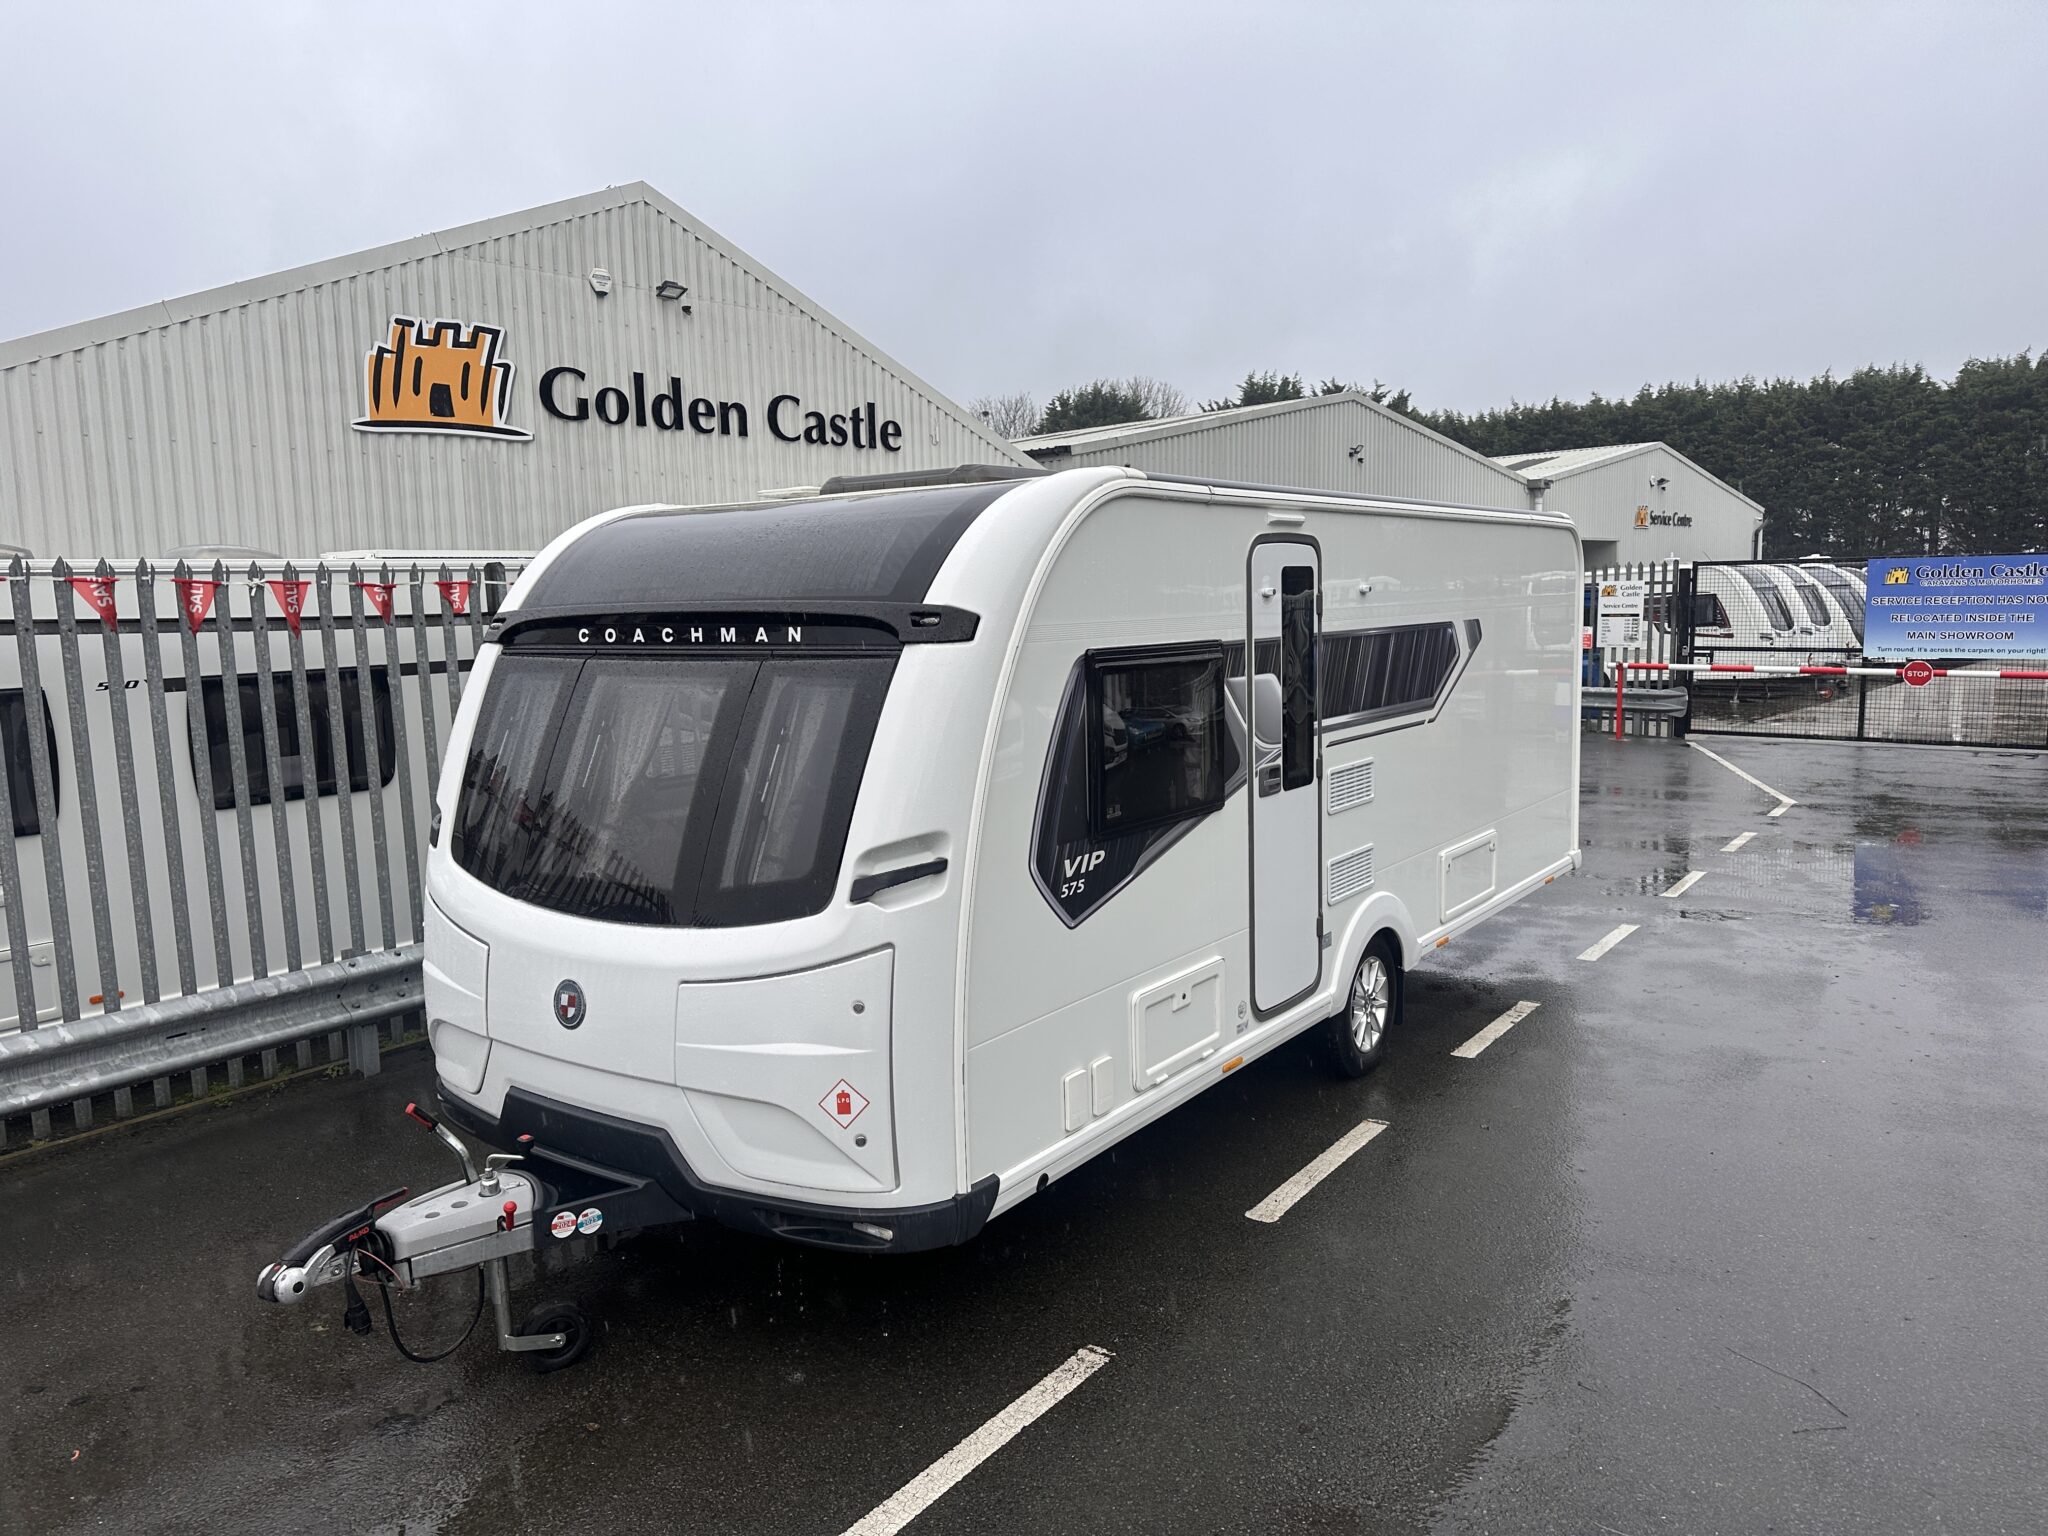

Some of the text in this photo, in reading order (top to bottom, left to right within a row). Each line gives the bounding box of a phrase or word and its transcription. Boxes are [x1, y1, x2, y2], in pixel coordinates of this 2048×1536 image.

[538, 365, 903, 451] Golden Castle
[1649, 510, 1693, 527] Service Centre
[1915, 562, 2048, 579] Golden Castle
[1920, 577, 2044, 587] CARAVANS & MOTORHOMES
[449, 584, 462, 609] SAL
[1872, 596, 1922, 606] SERVICE
[1924, 595, 1994, 606] RECEPTION
[1997, 594, 2024, 605] HAS
[1890, 613, 2035, 623] RELOCATED INSIDE THE
[578, 626, 802, 643] COACHMAN
[1907, 631, 2014, 640] MAIN SHOWROOM
[2026, 647, 2047, 655] right!
[1907, 670, 1930, 678] STOP
[95, 680, 140, 691] 50
[1064, 850, 1106, 878] VIP
[1061, 879, 1085, 898] 575
